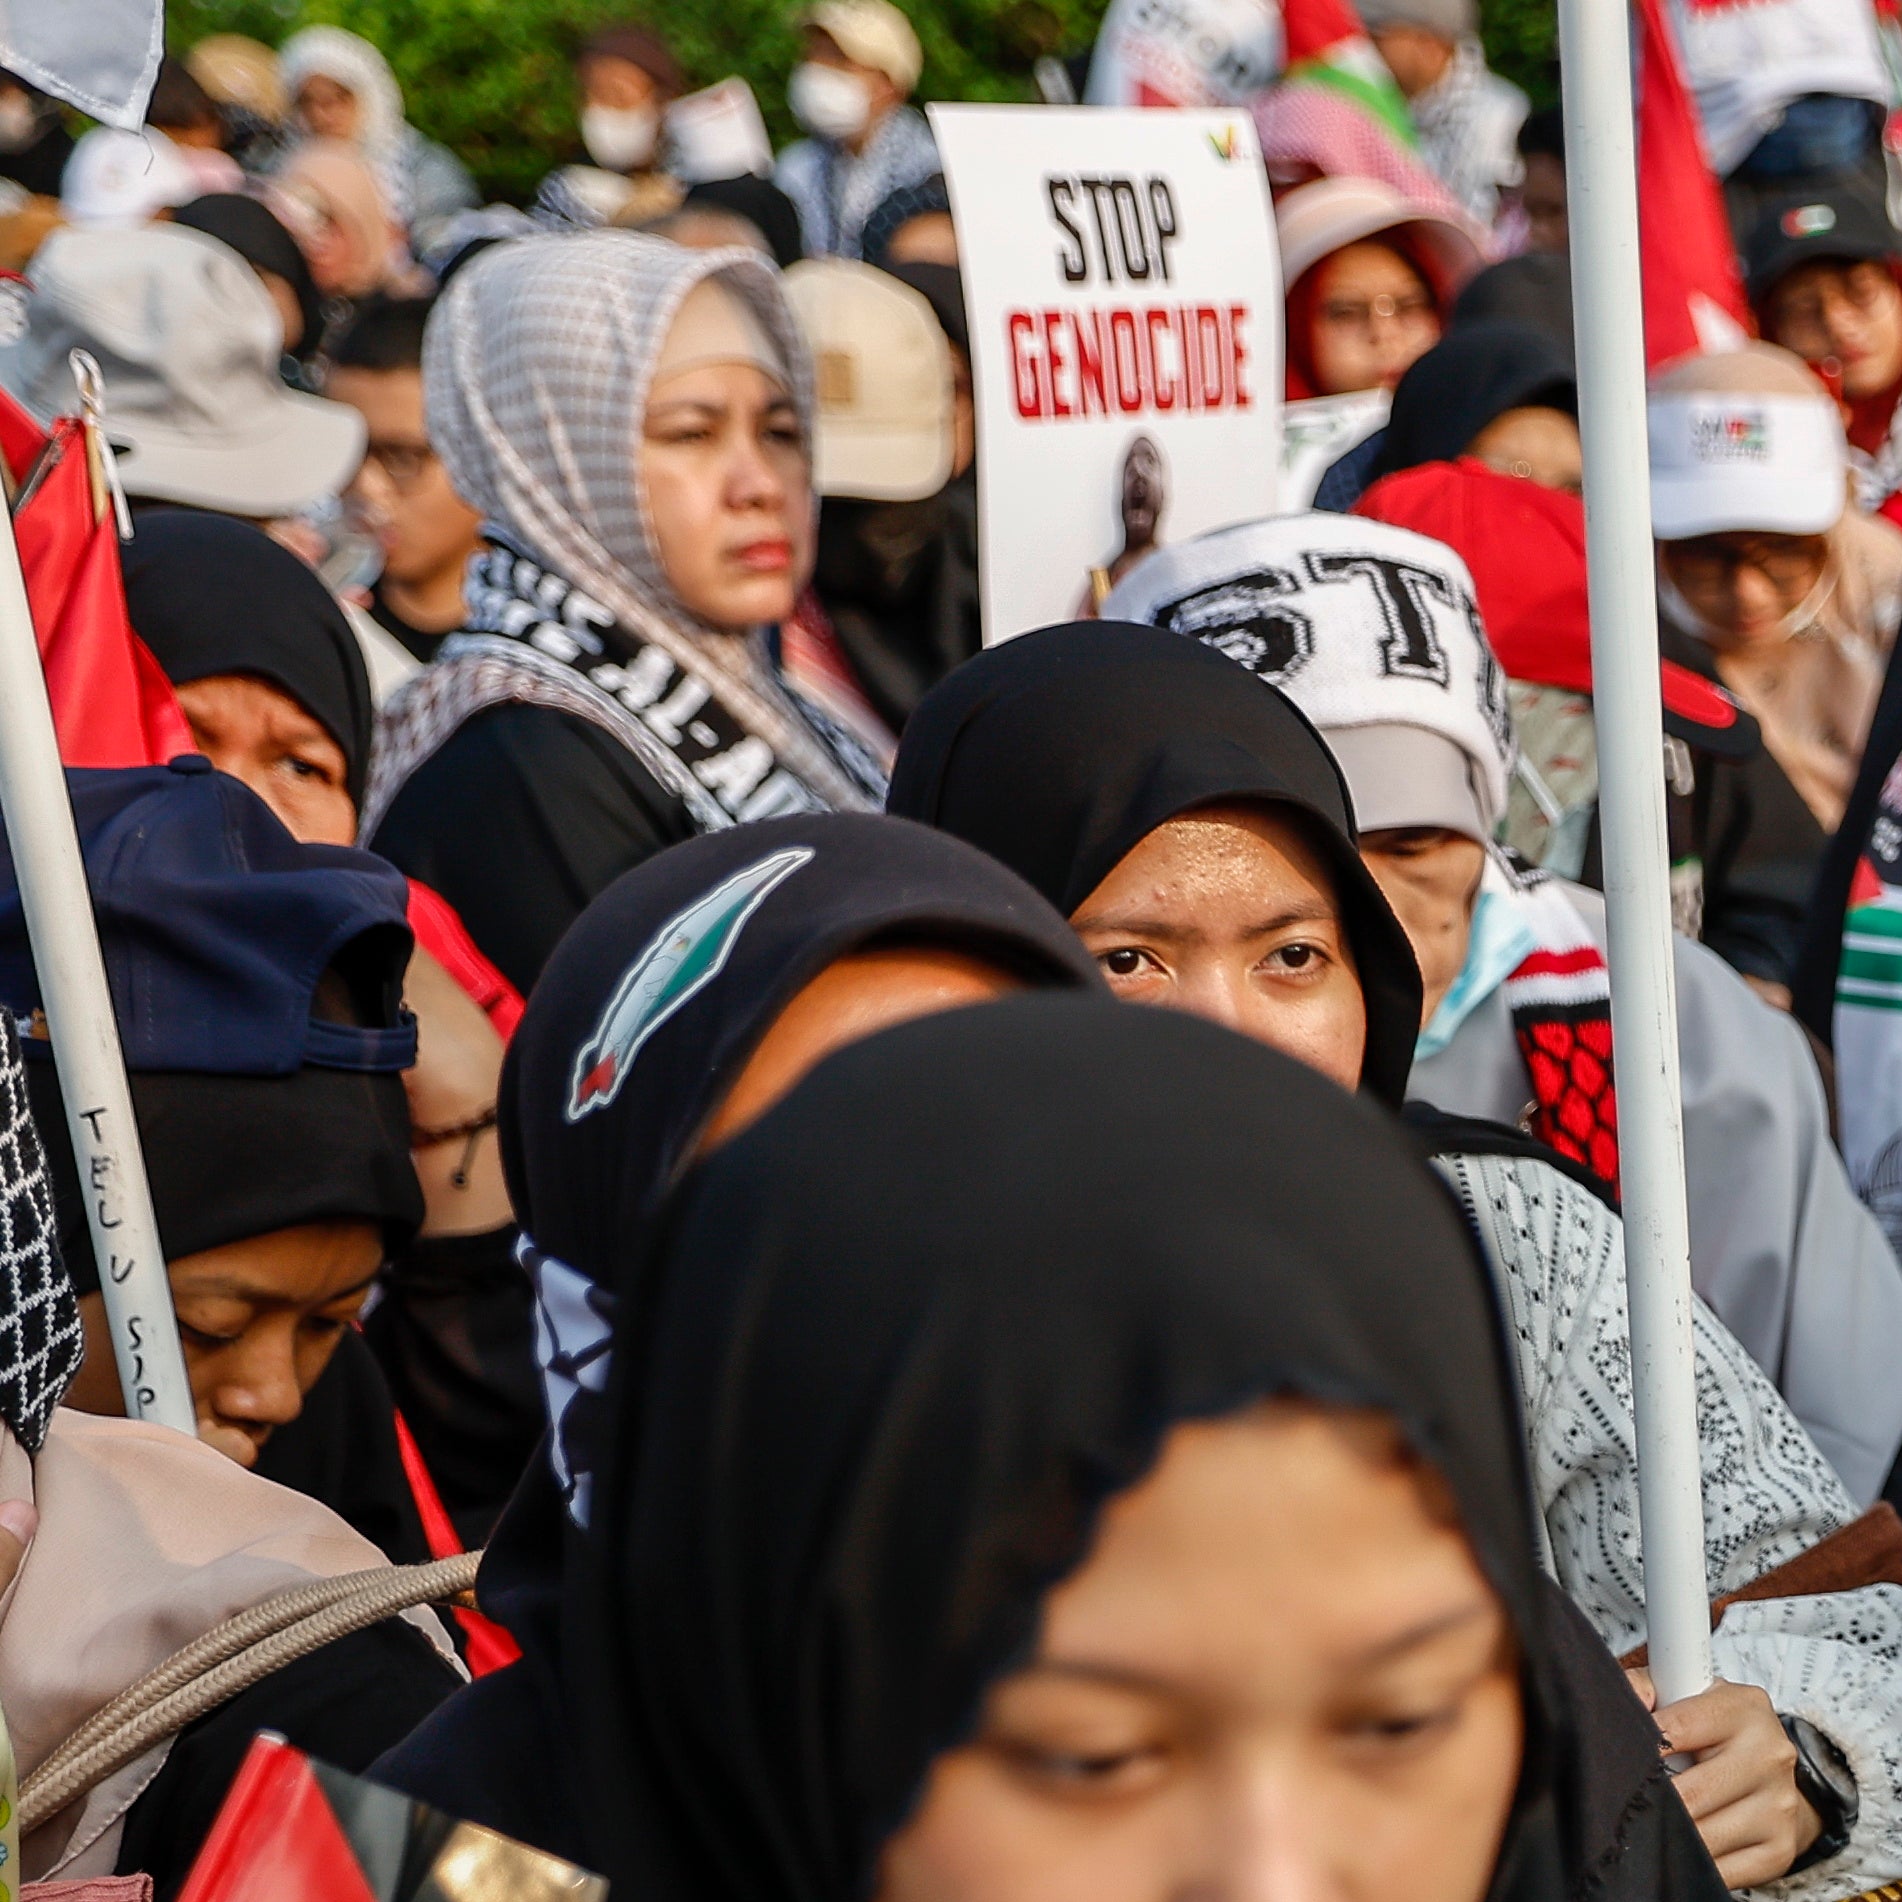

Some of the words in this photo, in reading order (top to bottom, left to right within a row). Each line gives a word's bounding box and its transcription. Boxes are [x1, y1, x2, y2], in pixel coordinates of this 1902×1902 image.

[1047, 177, 1178, 283] STOP
[1008, 303, 1250, 418] GENOCIDE
[1152, 550, 1515, 768] ST
